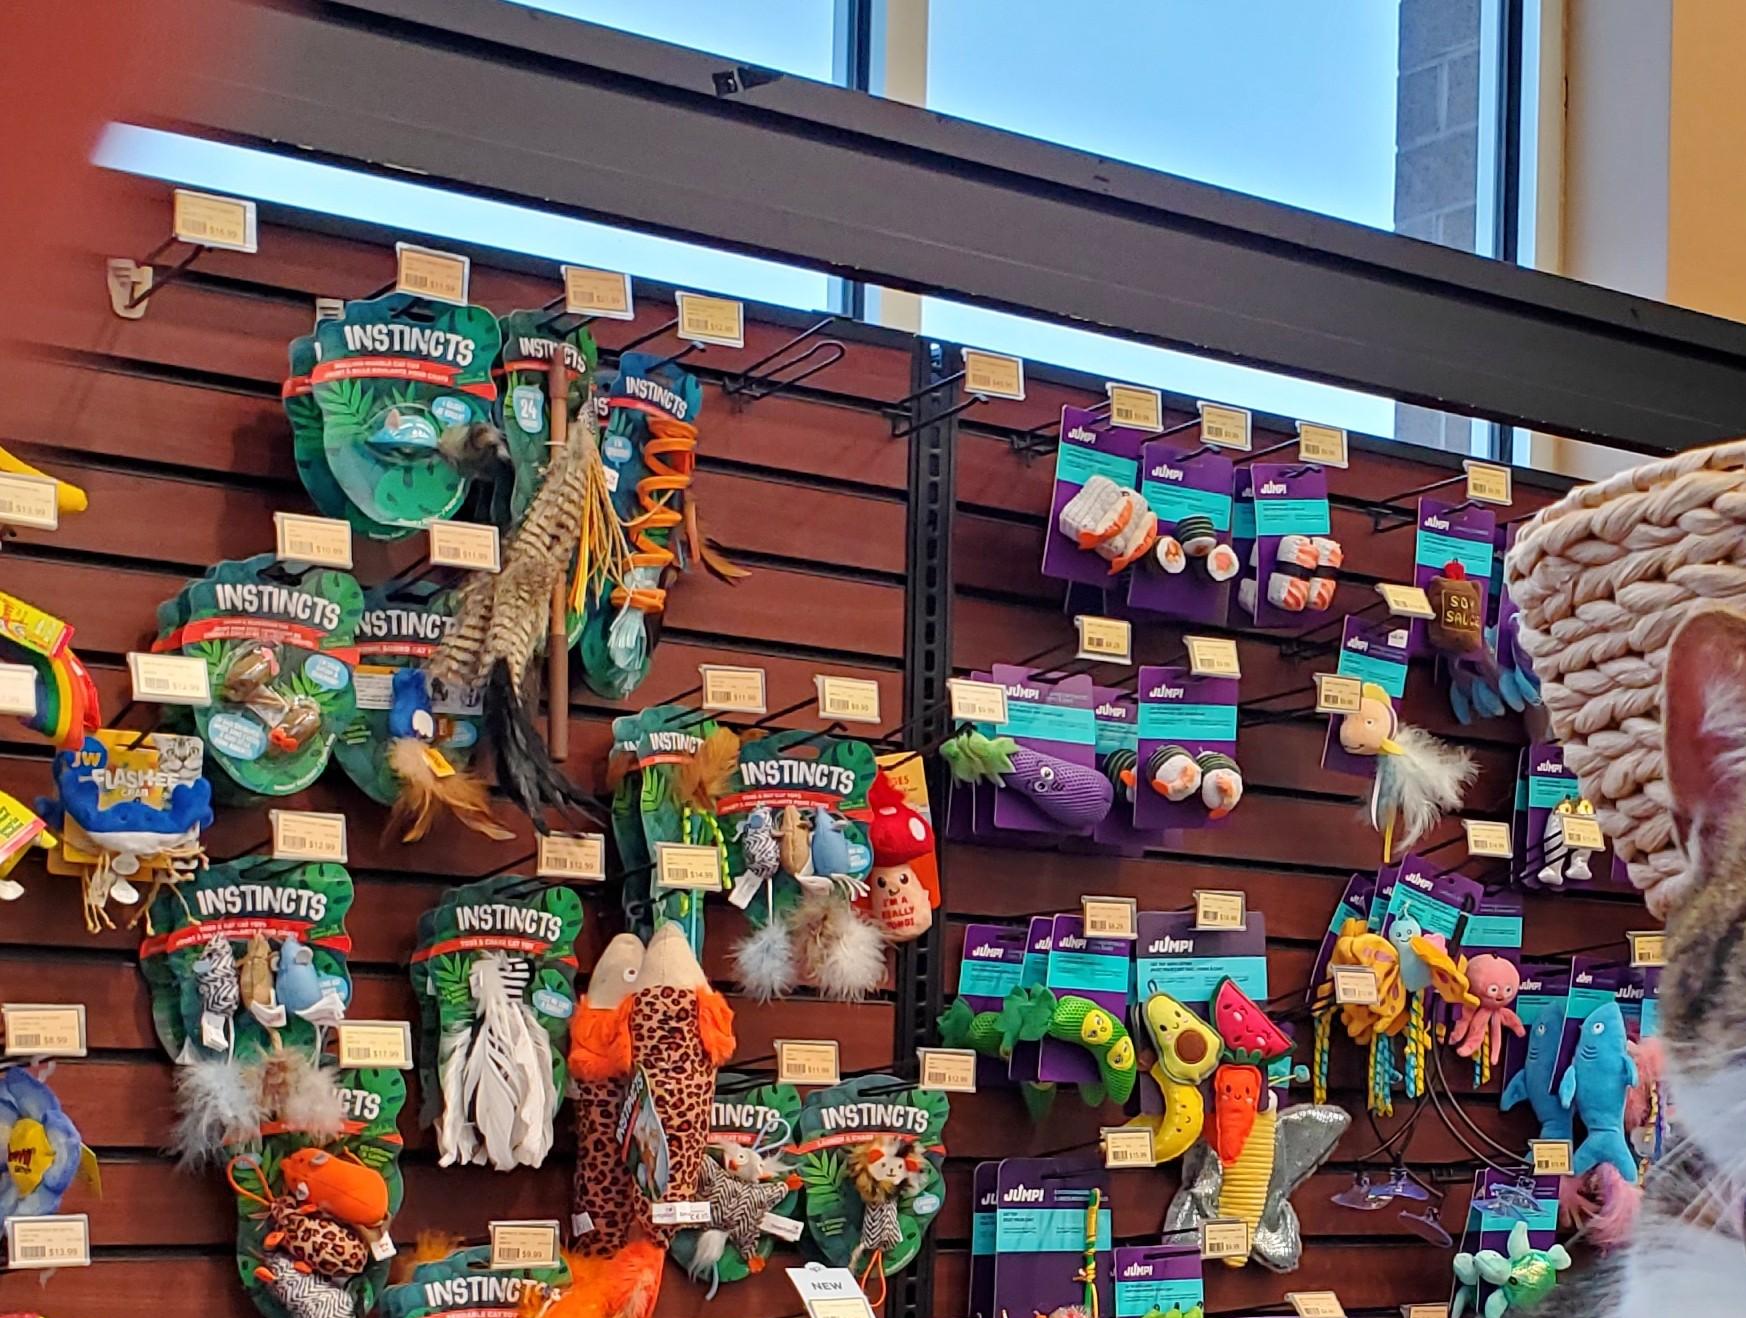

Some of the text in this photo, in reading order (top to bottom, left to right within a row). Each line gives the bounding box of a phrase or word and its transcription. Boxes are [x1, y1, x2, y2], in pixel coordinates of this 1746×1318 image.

[344, 324, 475, 366] INSTINCTS
[519, 337, 587, 373] INSTICTS
[520, 399, 537, 419] 24
[625, 376, 688, 419] INSTINCTS
[215, 584, 341, 630] INSTINCTS
[354, 609, 455, 640] NSTINCT
[650, 732, 704, 754] INSTINCT
[740, 760, 855, 794] INSTINCTS
[309, 840, 336, 850] $12.99
[690, 870, 713, 878] $14.99
[1405, 872, 1433, 891] JUMP!
[196, 885, 327, 921] INSTINCTS
[900, 897, 908, 905] A
[456, 904, 562, 941] INSTINCTS
[711, 1102, 780, 1132] TINCTS
[820, 1102, 929, 1133] INSTINCTS
[49, 1248, 78, 1257] $13.99
[522, 1250, 542, 1258] $9.99
[811, 1280, 843, 1291] NEW
